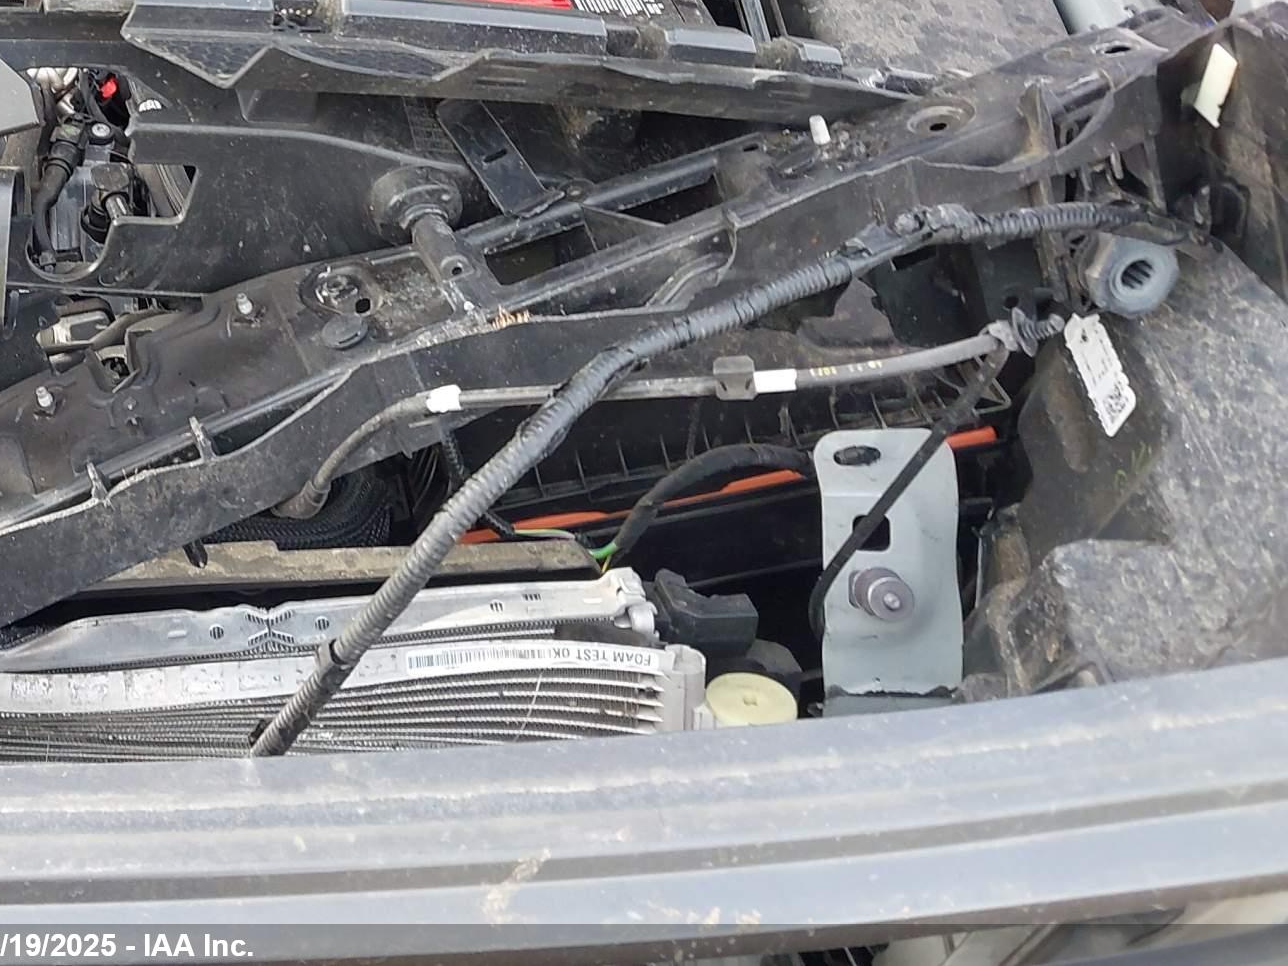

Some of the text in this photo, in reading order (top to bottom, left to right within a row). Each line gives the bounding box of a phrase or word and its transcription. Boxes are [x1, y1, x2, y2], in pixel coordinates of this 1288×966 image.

[552, 647, 651, 667] FOAM TEST OK
